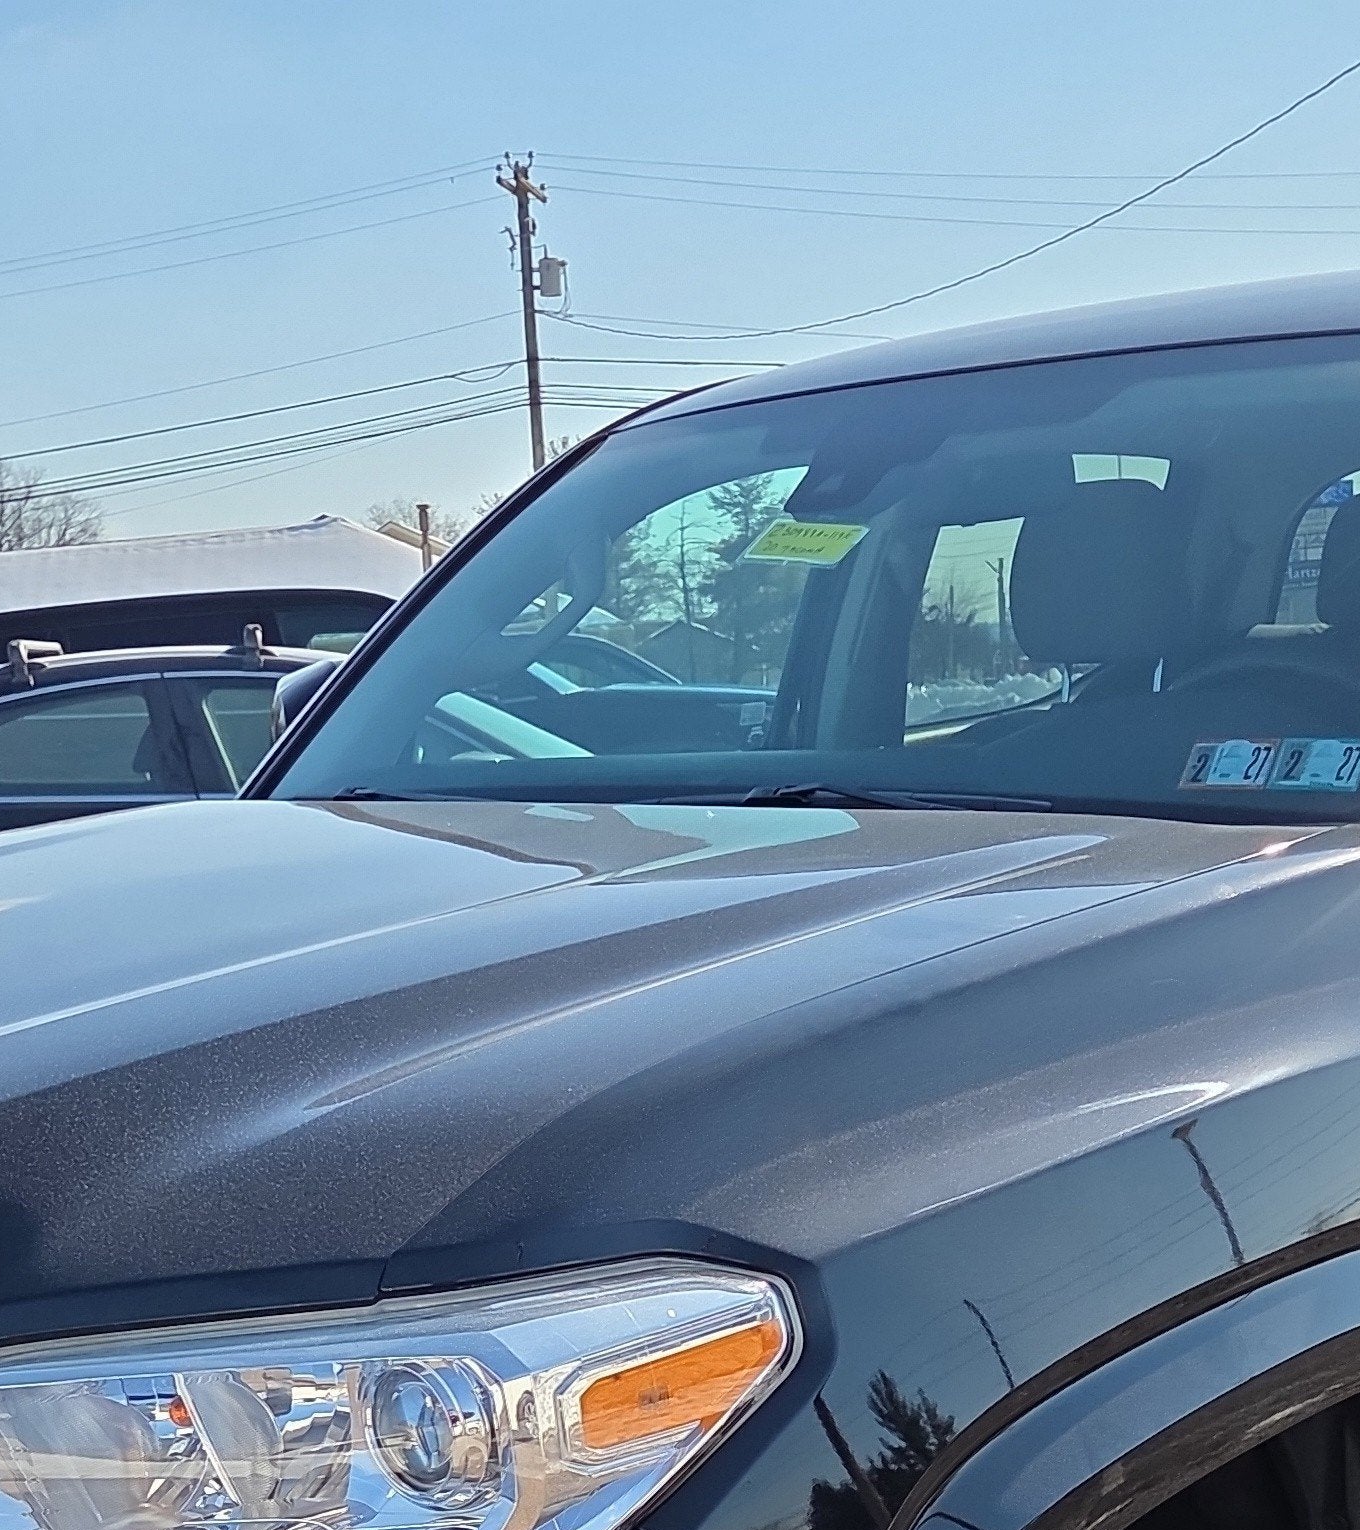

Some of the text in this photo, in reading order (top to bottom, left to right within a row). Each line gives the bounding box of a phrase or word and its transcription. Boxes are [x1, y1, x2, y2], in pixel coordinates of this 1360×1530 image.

[1190, 746, 1272, 783] 2 27
[1283, 748, 1303, 781] 2
